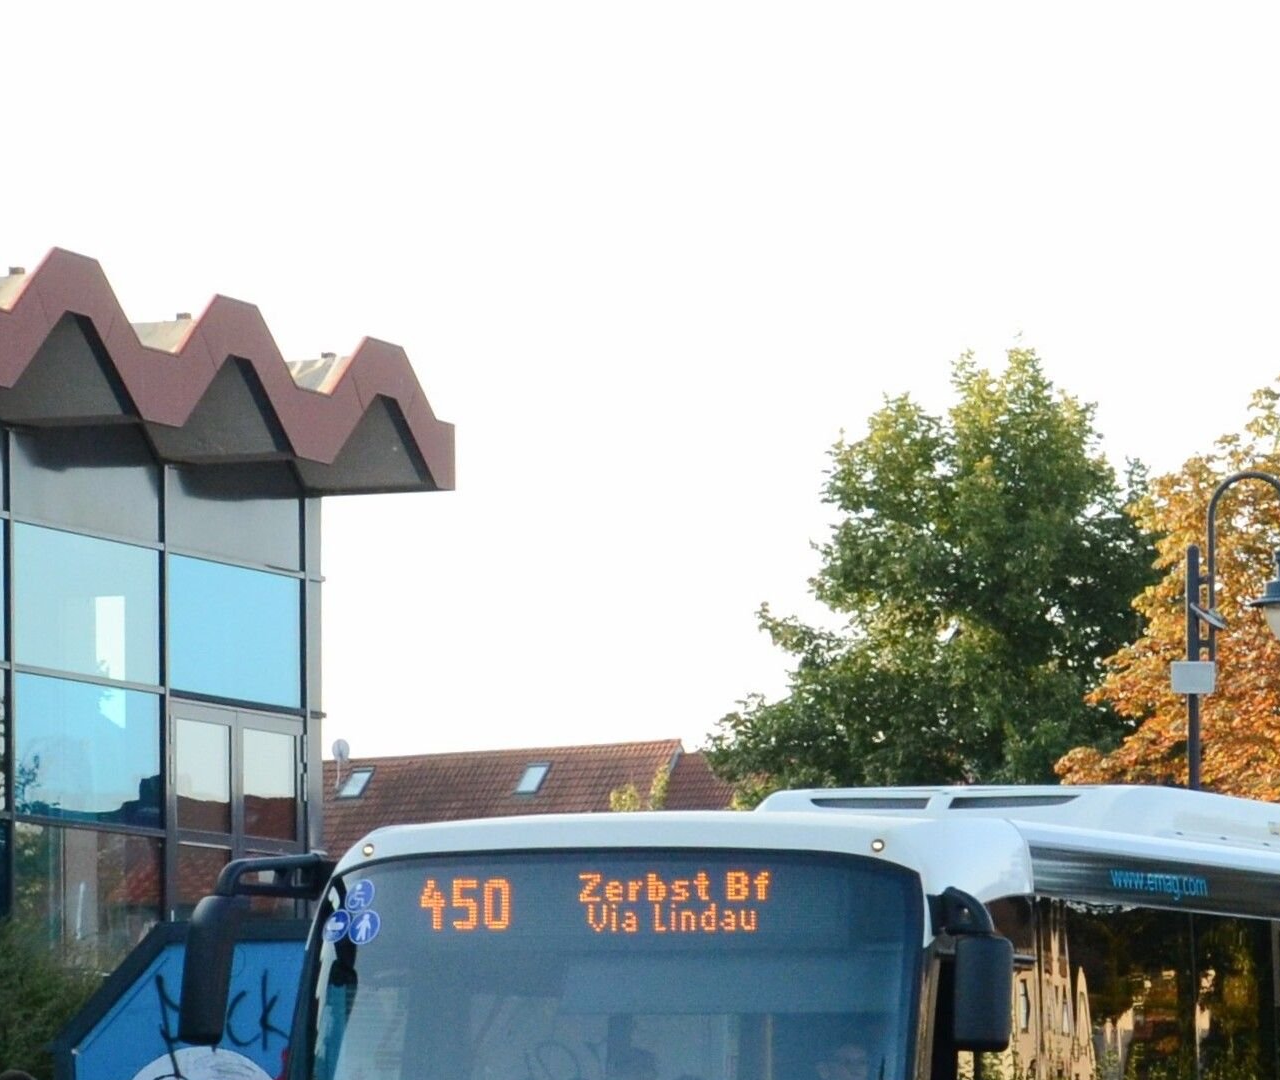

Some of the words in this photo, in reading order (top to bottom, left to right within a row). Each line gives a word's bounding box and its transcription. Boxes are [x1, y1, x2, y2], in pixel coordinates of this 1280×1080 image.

[1110, 869, 1208, 900] www.emag.com
[421, 879, 510, 930] 450
[579, 872, 710, 902] Zerbst
[727, 871, 769, 901] Bf
[587, 903, 638, 932] Via
[654, 903, 757, 932] Lindau
